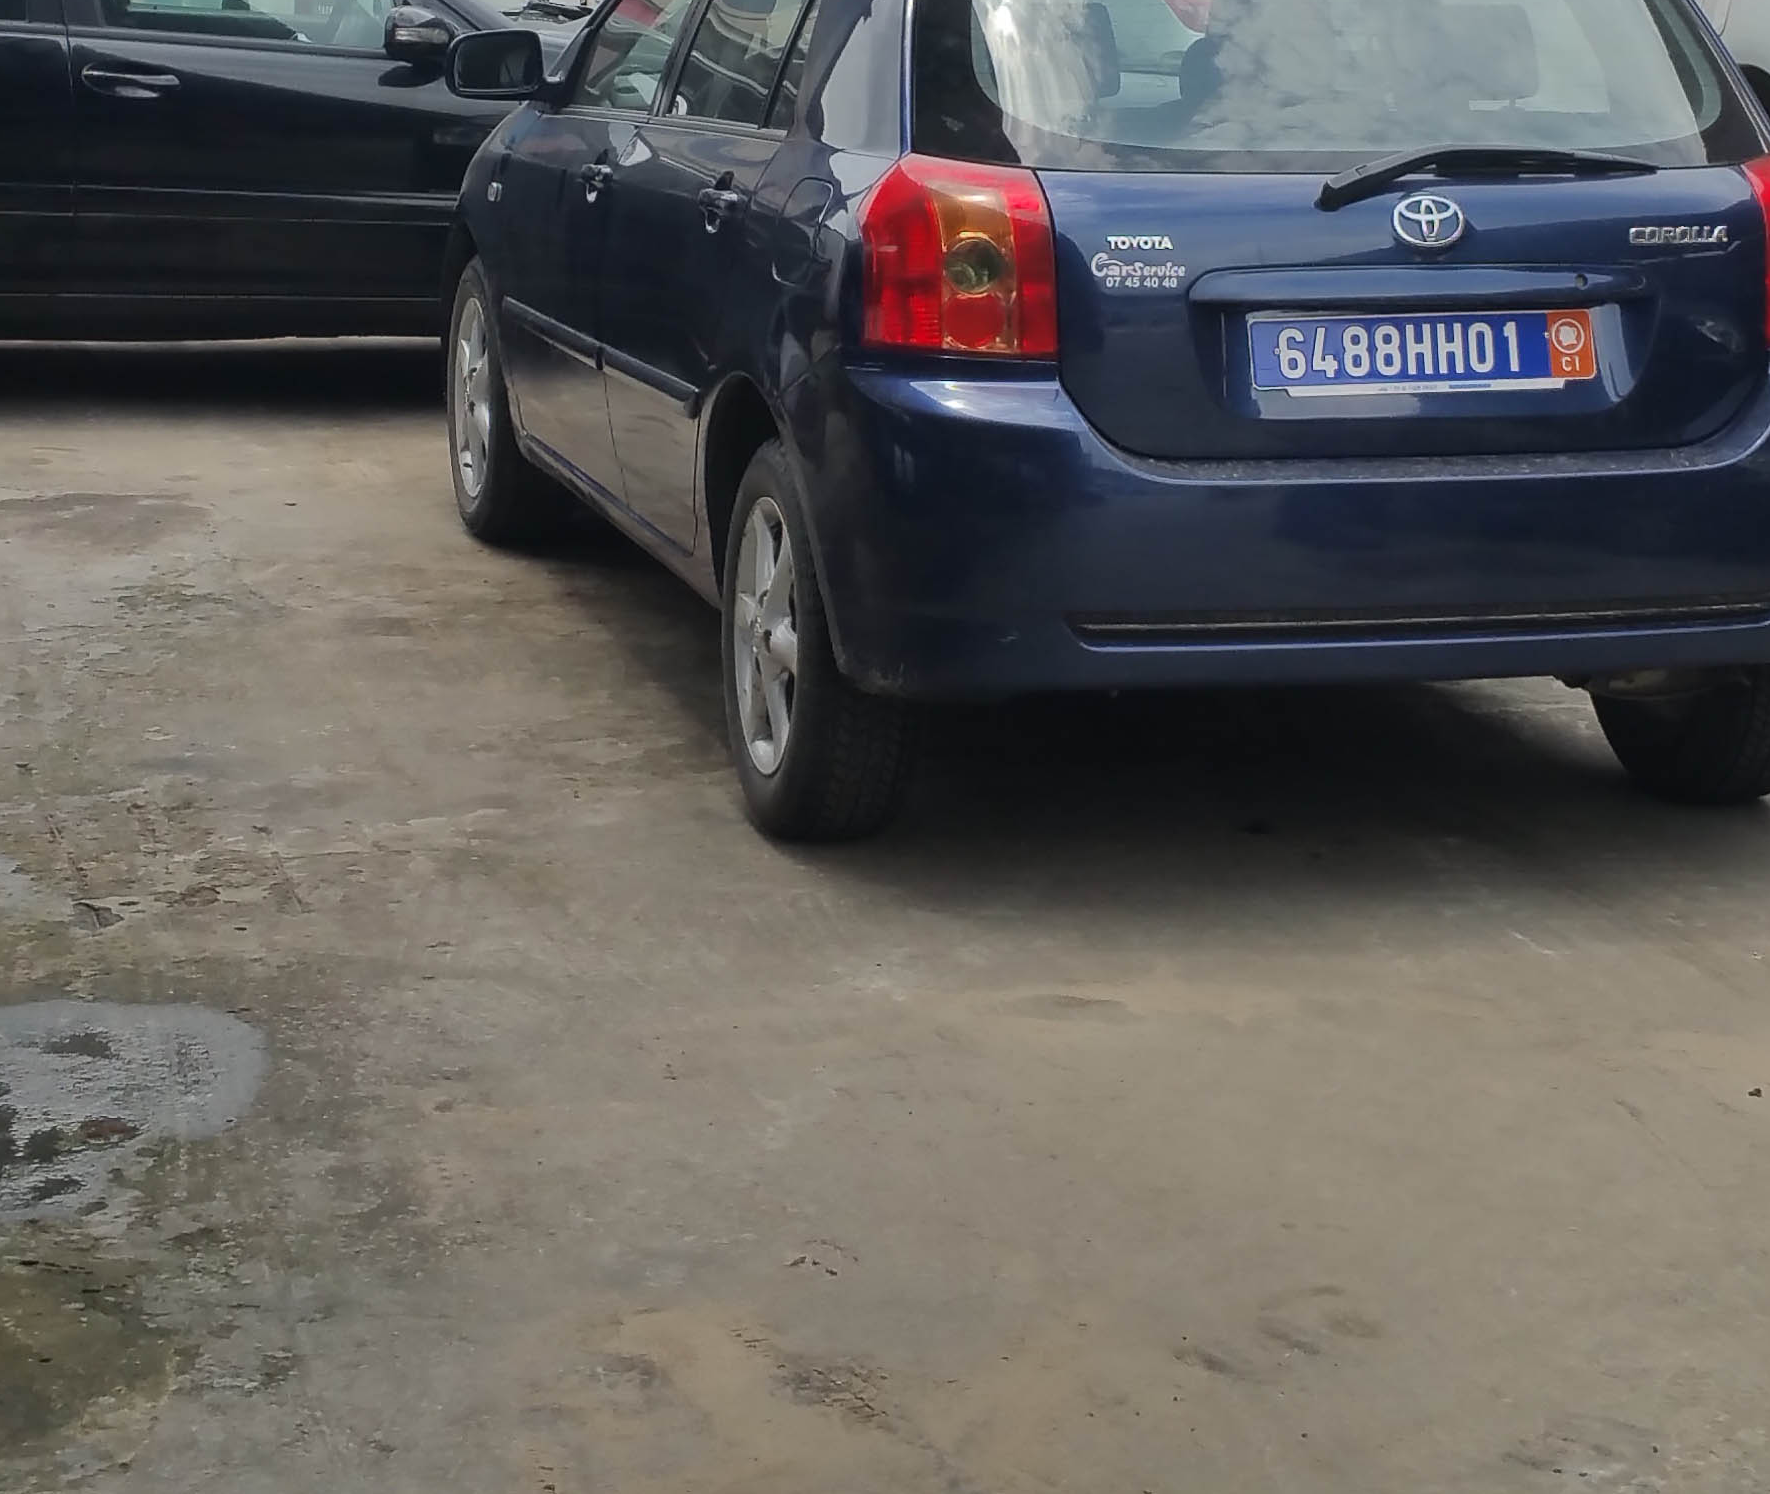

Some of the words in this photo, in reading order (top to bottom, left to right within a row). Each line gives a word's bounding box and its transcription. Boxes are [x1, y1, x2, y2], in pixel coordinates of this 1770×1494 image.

[1106, 235, 1174, 250] TOYOTA
[1629, 226, 1728, 244] COROLLA
[1105, 276, 1121, 288] 07
[1124, 276, 1140, 288] 45
[1143, 276, 1159, 288] 40
[1162, 276, 1178, 288] 40
[1278, 321, 1520, 379] 6488HH01
